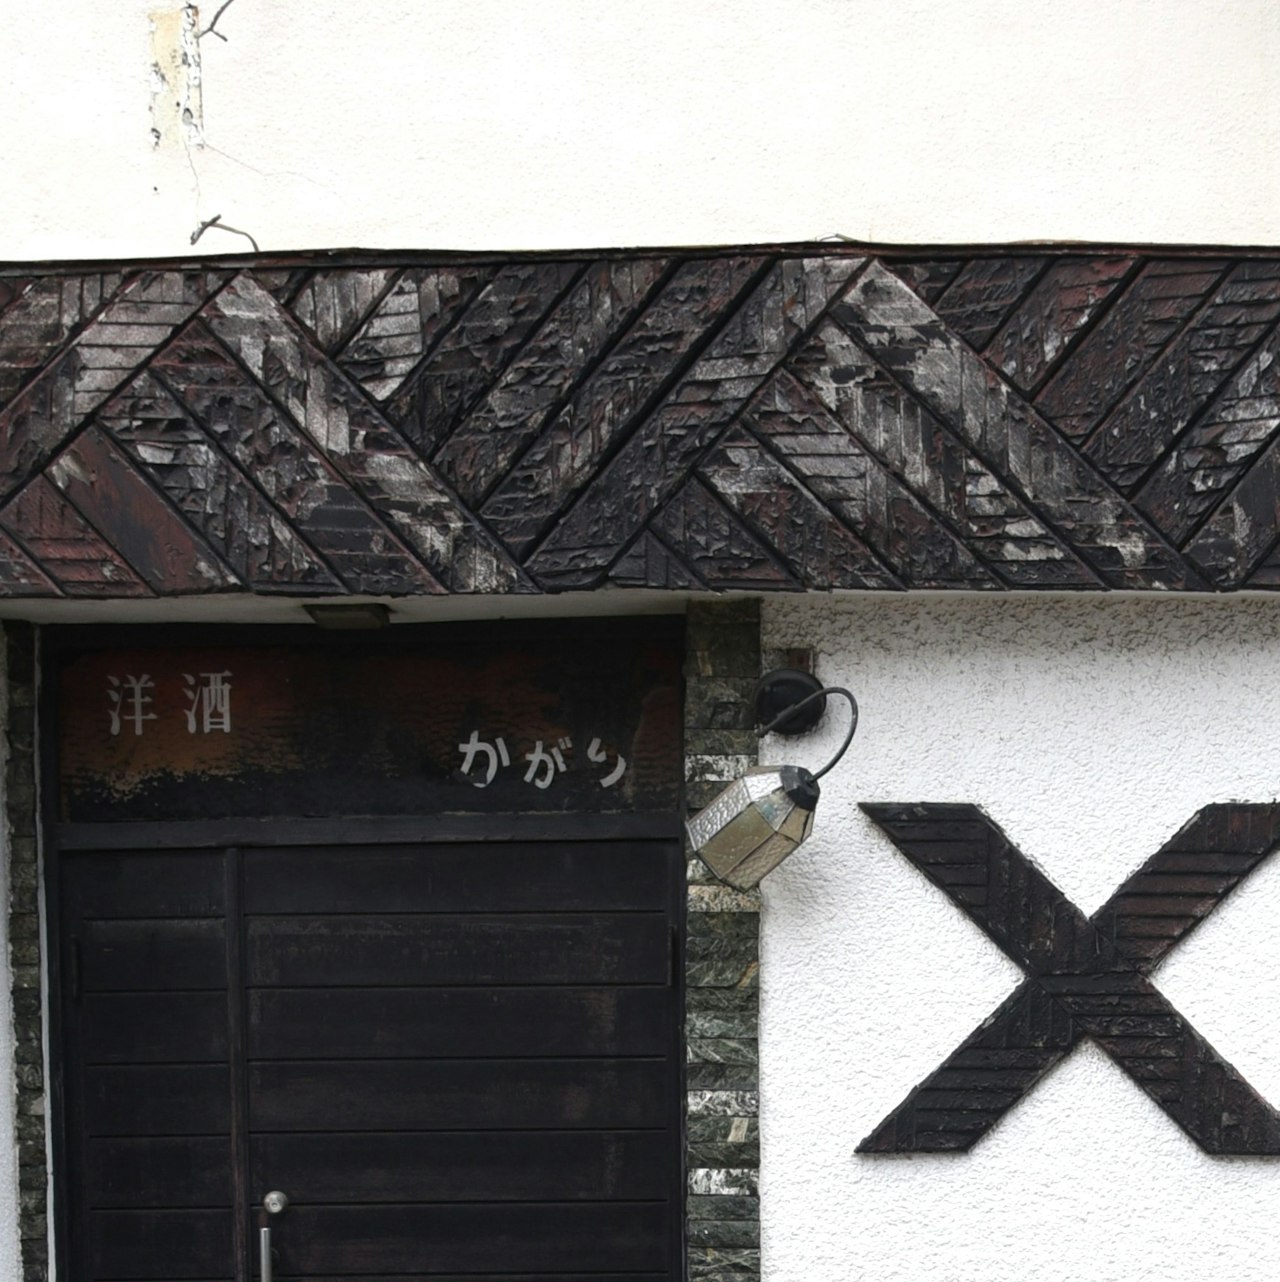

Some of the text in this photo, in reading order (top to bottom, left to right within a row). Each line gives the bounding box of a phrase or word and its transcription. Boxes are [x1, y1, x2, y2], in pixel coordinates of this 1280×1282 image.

[107, 670, 233, 737] 洋酒
[459, 730, 627, 789] かがり
